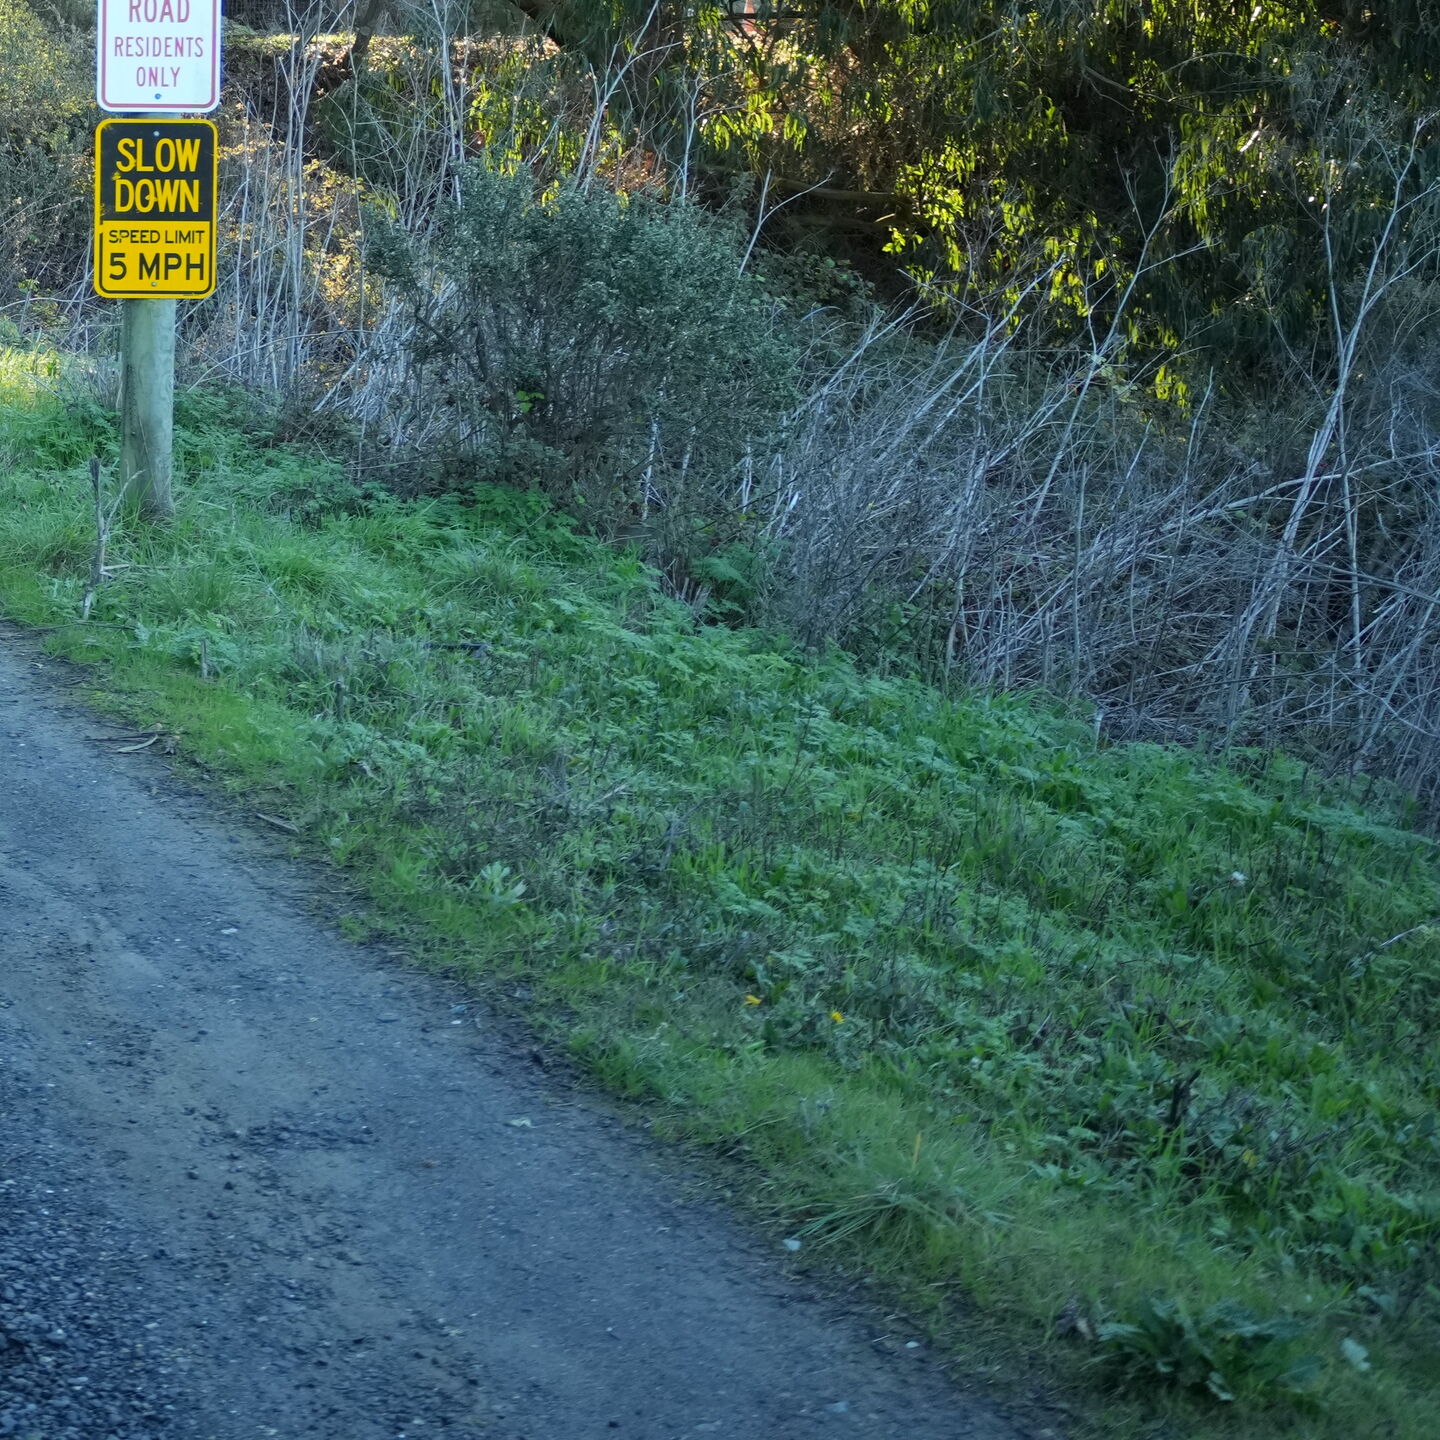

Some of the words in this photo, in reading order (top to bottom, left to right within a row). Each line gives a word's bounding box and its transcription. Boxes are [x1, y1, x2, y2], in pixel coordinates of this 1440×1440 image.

[114, 36, 204, 58] RESIDENTS
[136, 66, 181, 88] ONLY
[116, 137, 201, 173] SLOW
[115, 179, 199, 214] DOWN
[108, 230, 160, 244] SPEED
[165, 230, 205, 244] LIMIT
[109, 252, 127, 281] 5
[138, 252, 205, 281] MPH
